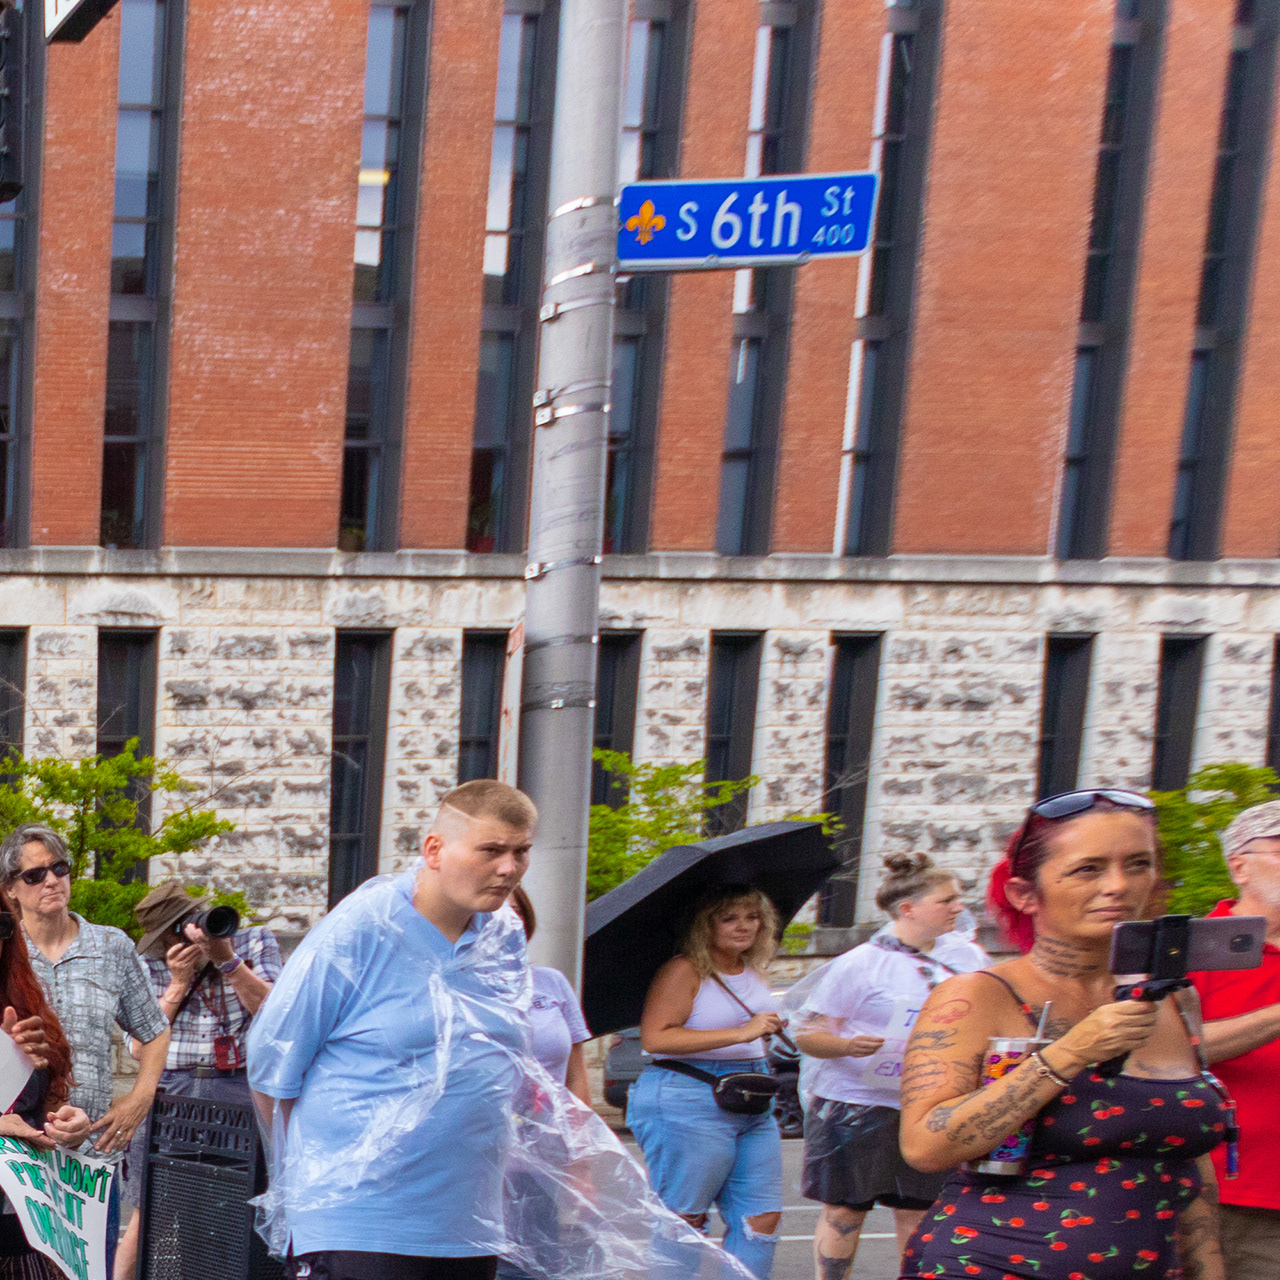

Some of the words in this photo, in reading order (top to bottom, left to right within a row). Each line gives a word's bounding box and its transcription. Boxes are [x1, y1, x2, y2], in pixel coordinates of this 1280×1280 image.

[675, 201, 700, 242] S
[710, 190, 803, 250] 6th
[819, 184, 856, 218] St
[810, 223, 856, 247] 400
[56, 1150, 111, 1203] WON'T
